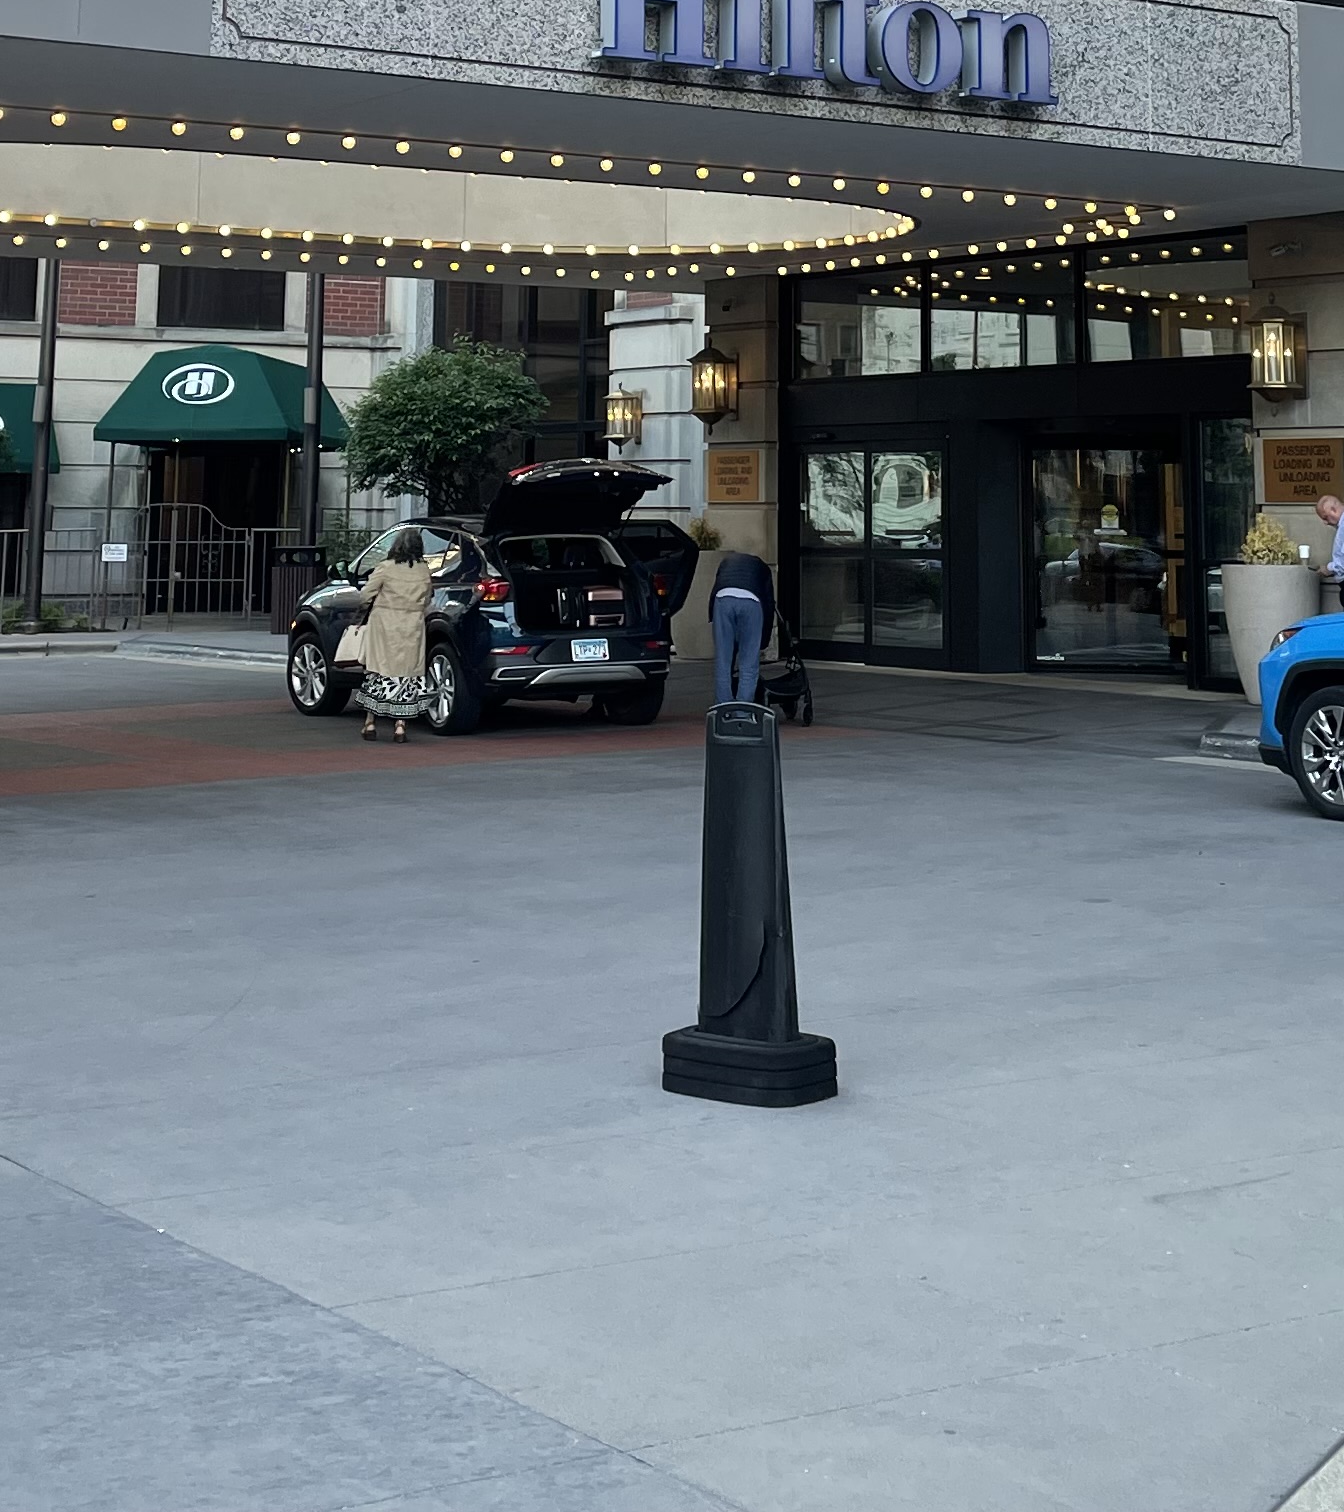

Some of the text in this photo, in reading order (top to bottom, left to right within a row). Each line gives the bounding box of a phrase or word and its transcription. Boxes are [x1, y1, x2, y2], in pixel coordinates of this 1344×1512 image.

[1276, 444, 1331, 456] PASSENGER
[1273, 458, 1335, 470] LOADING AND
[1279, 471, 1331, 483] UNLOADING
[1293, 484, 1318, 496] AREA
